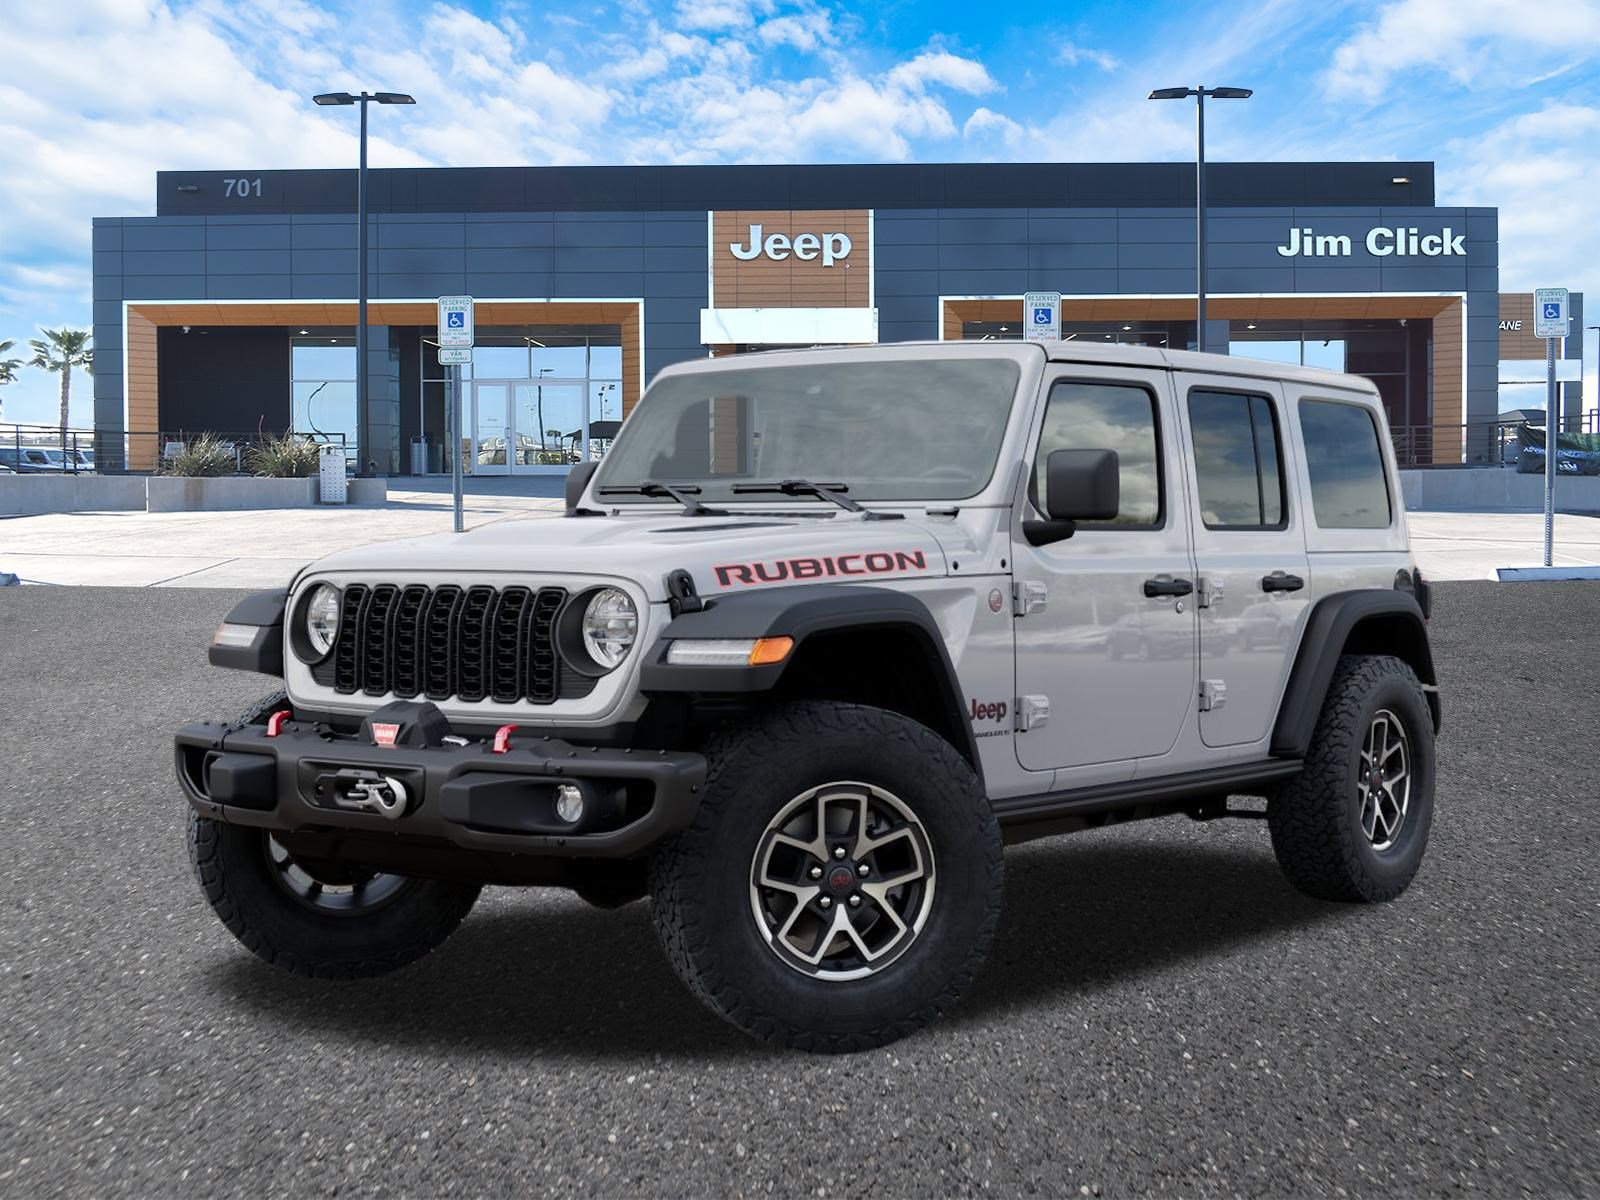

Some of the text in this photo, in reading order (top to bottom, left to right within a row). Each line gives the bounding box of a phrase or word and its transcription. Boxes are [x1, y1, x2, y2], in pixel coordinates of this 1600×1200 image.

[223, 178, 261, 197] 701
[729, 223, 852, 268] Jeep
[1277, 226, 1467, 257] Jim Click
[1498, 320, 1522, 331] ANE
[714, 550, 927, 588] RUBICON
[969, 698, 1007, 723] Jeep
